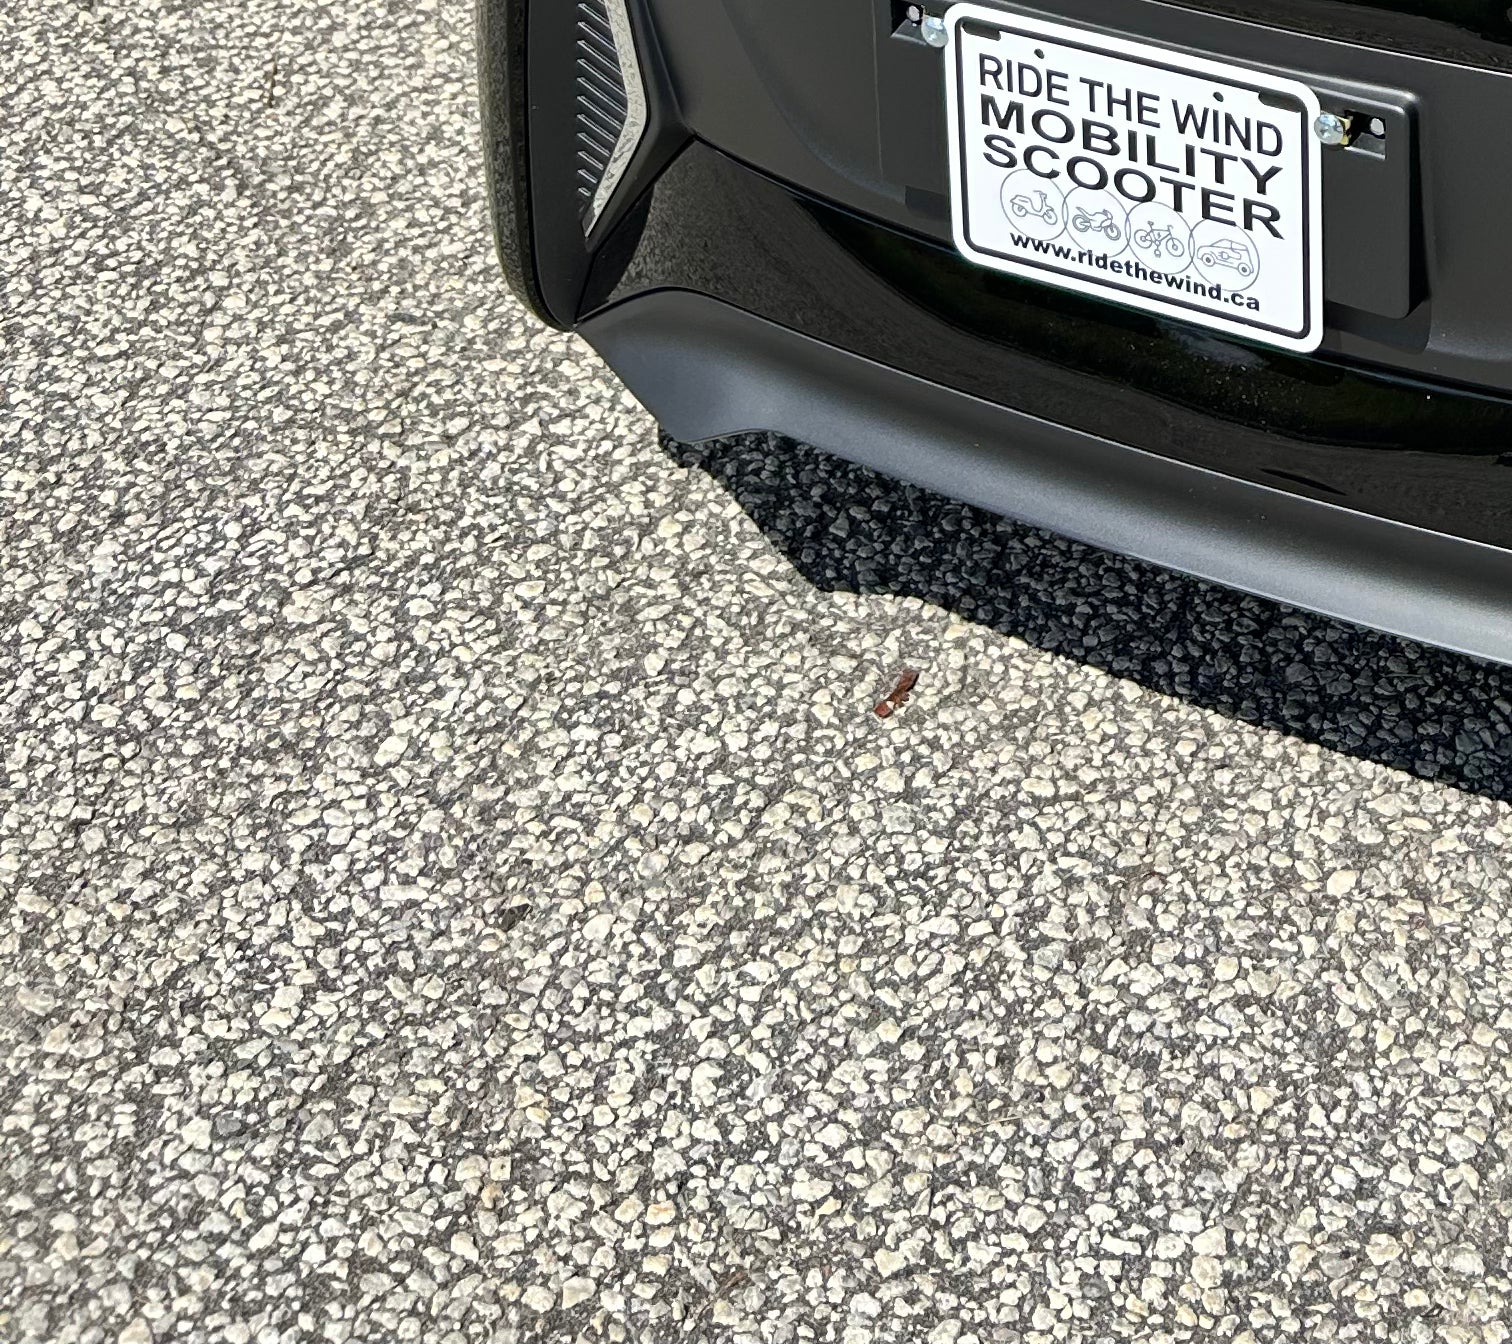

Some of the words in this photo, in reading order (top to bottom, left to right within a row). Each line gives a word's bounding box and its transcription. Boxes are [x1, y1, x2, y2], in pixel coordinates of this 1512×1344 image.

[978, 53, 1070, 107] RIDE
[1079, 76, 1161, 129] THE
[1171, 99, 1283, 158] WIND
[980, 94, 1284, 196] MOBILITY
[982, 133, 1285, 240] SCOOTER
[1009, 232, 1261, 312] www.ridethewind.ca
